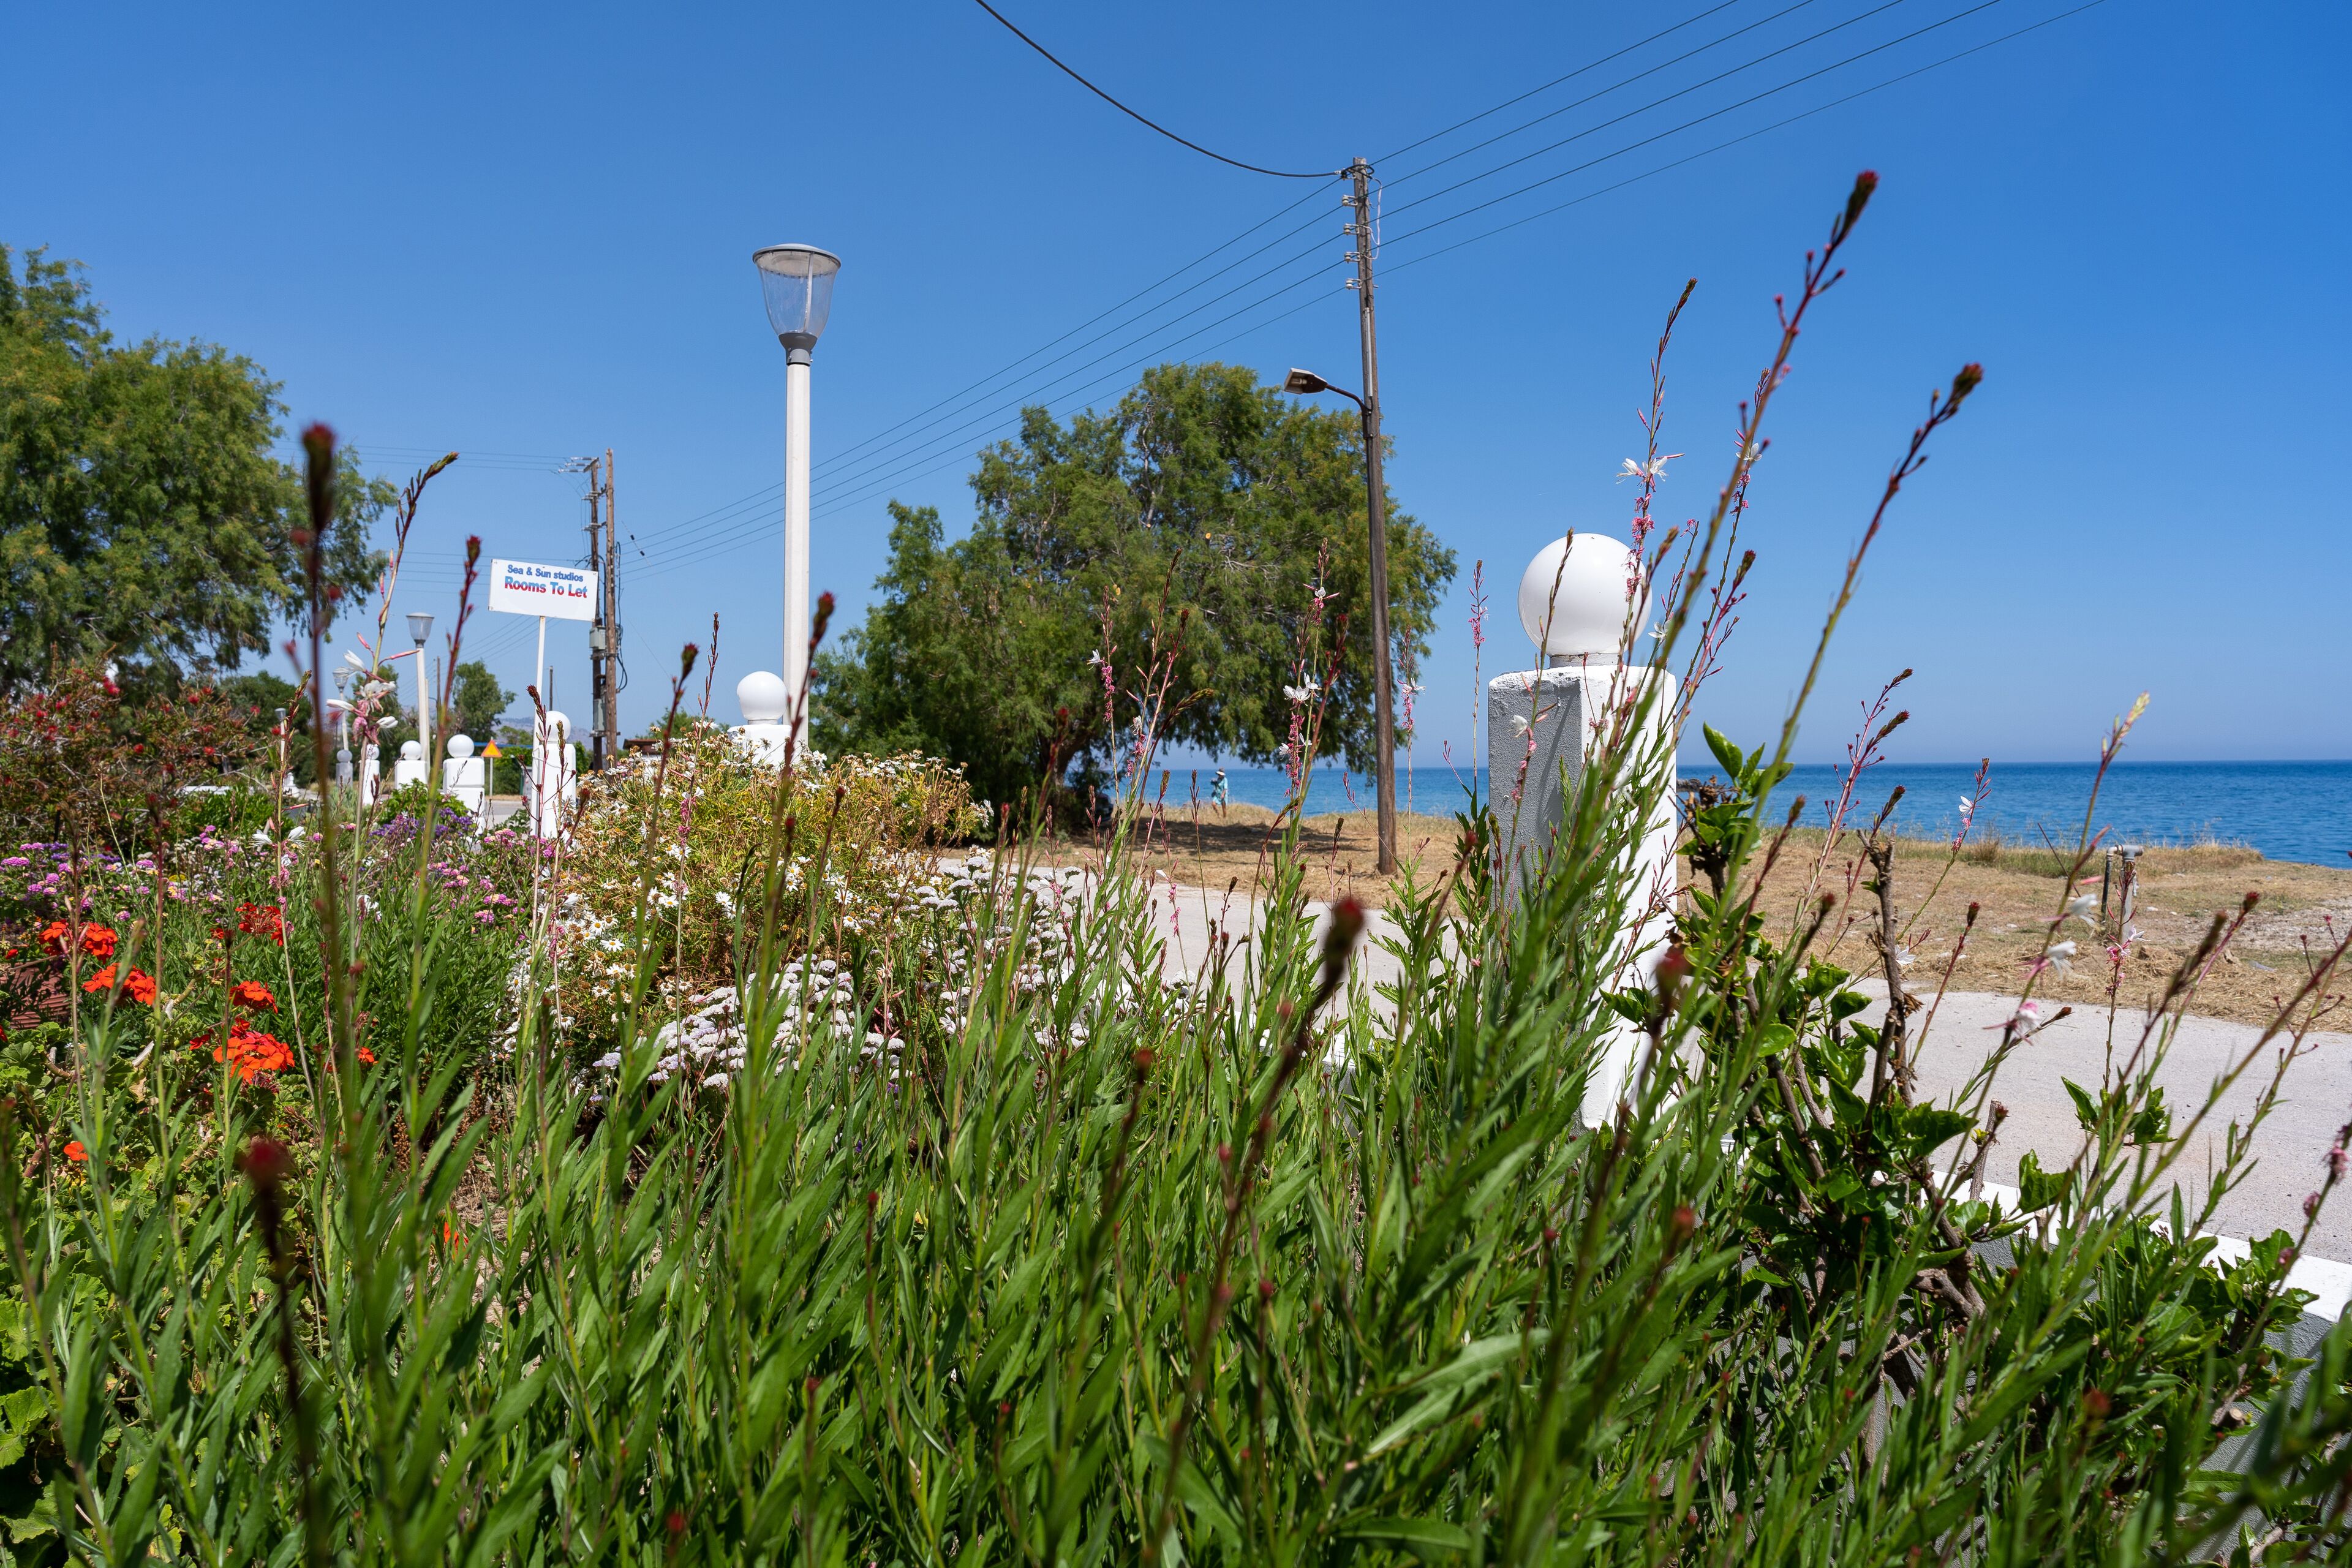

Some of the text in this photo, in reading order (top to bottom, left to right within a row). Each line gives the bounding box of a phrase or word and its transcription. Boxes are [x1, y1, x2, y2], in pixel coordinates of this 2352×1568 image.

[507, 564, 584, 582] Sea & Sun studios
[504, 576, 588, 598] Rooms To Let
